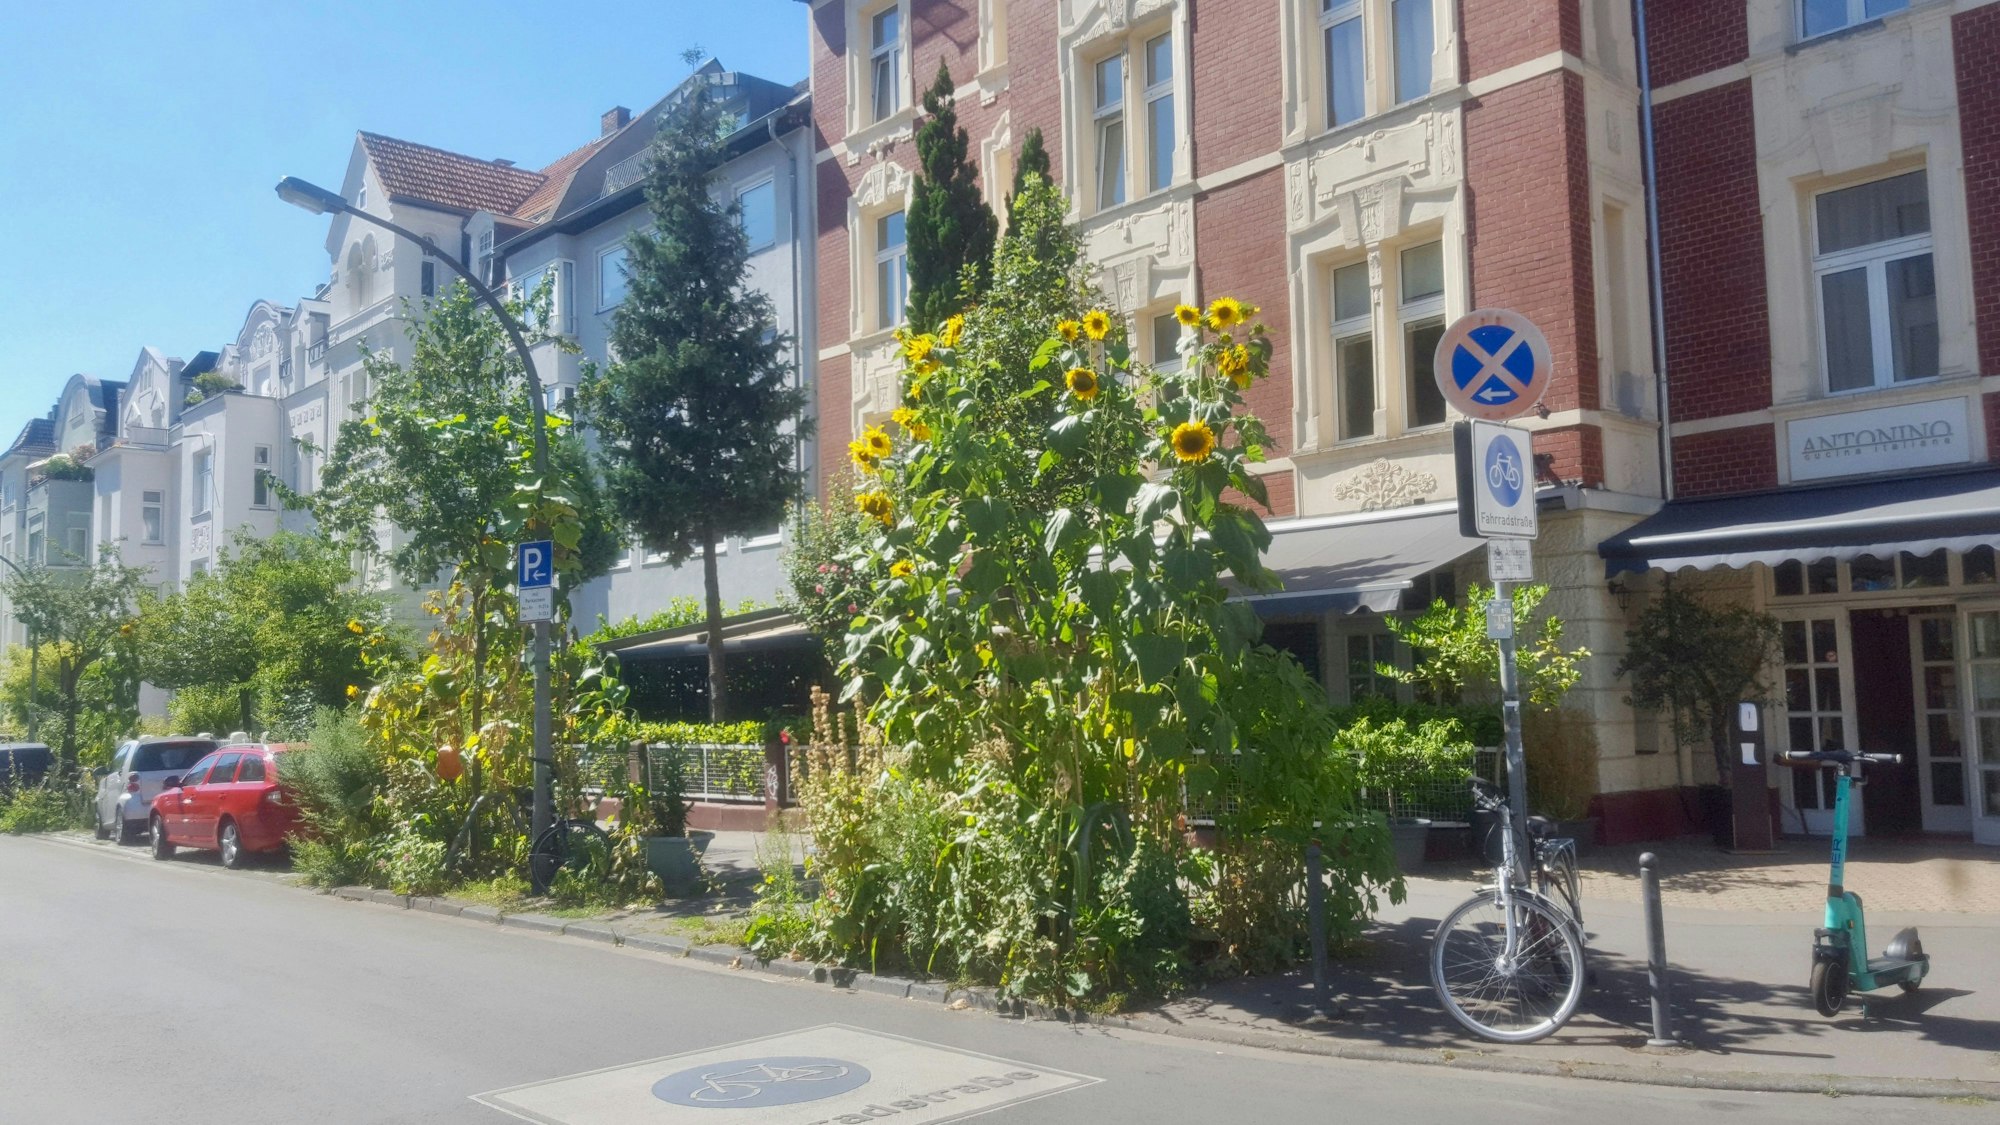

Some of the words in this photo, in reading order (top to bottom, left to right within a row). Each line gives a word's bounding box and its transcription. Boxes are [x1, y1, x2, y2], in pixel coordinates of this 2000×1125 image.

[1803, 420, 1954, 452] ANTONINO
[1804, 447, 1861, 461] cucina
[1874, 437, 1950, 453] italiana
[1480, 511, 1533, 528] Fahrradstraße
[524, 548, 542, 582] P
